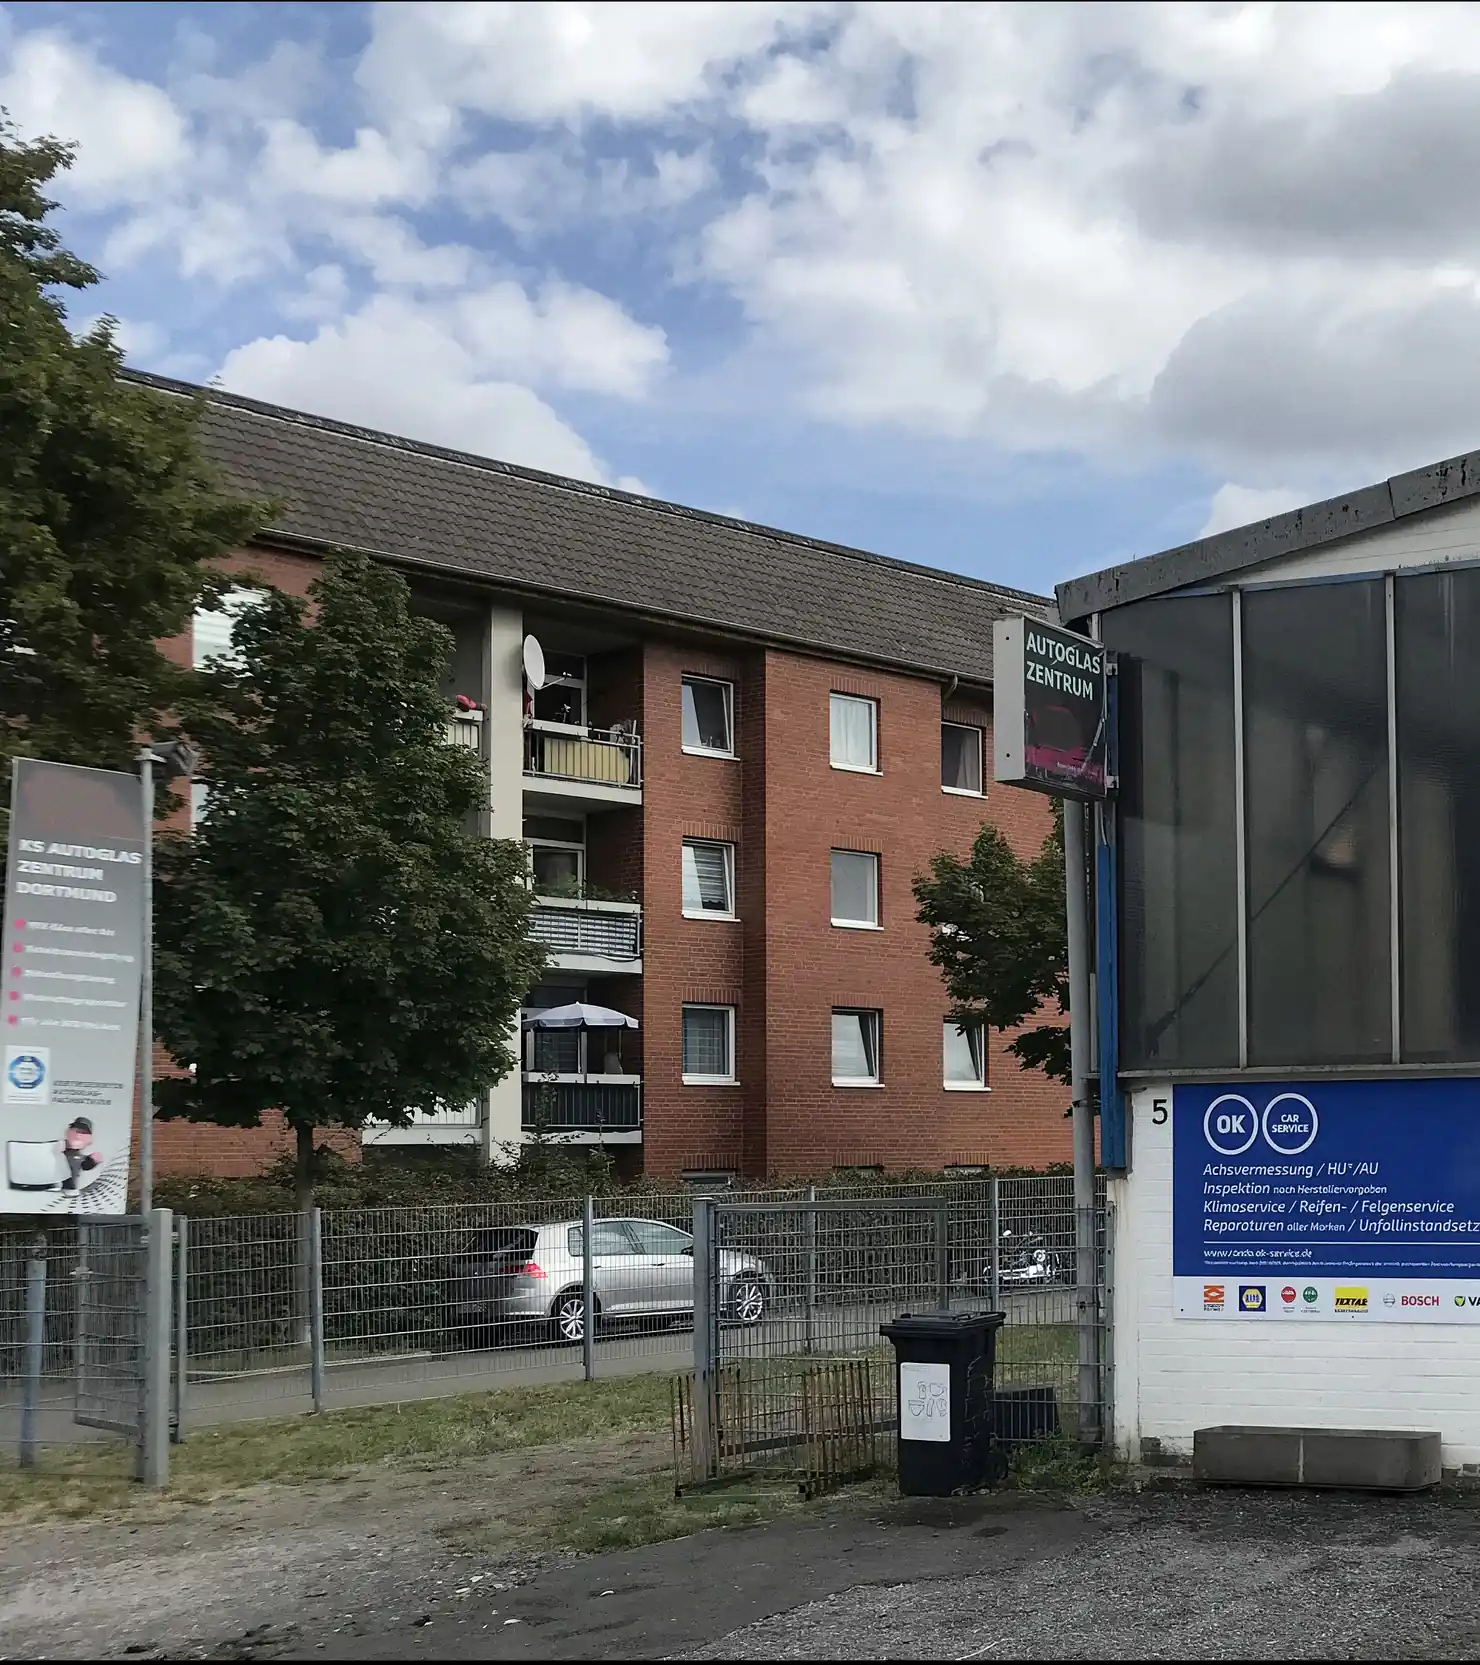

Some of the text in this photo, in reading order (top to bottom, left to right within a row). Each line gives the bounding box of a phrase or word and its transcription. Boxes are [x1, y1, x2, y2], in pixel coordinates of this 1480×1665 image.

[1026, 631, 1101, 675] AUTOGLAS
[1026, 660, 1093, 701] ZENTRUM
[18, 839, 144, 864] KS AUTOGLAS
[17, 859, 104, 881] ZENTRUM
[15, 881, 118, 903] DORTMUND
[1152, 1099, 1169, 1125] 5
[1280, 1114, 1300, 1123] CAR
[1216, 1114, 1247, 1134] OK
[1271, 1124, 1310, 1133] SERVICE
[1203, 1163, 1314, 1178] Achsvermessung
[1316, 1162, 1326, 1177] /
[1203, 1182, 1270, 1197] Inspektion
[1203, 1200, 1455, 1216] Klimaservice / Reifen- / Felgenservice
[1203, 1218, 1284, 1234] Reparaturen
[1310, 1222, 1346, 1232] Marken
[1347, 1219, 1357, 1233] /
[1401, 1295, 1440, 1307] BOSCH
